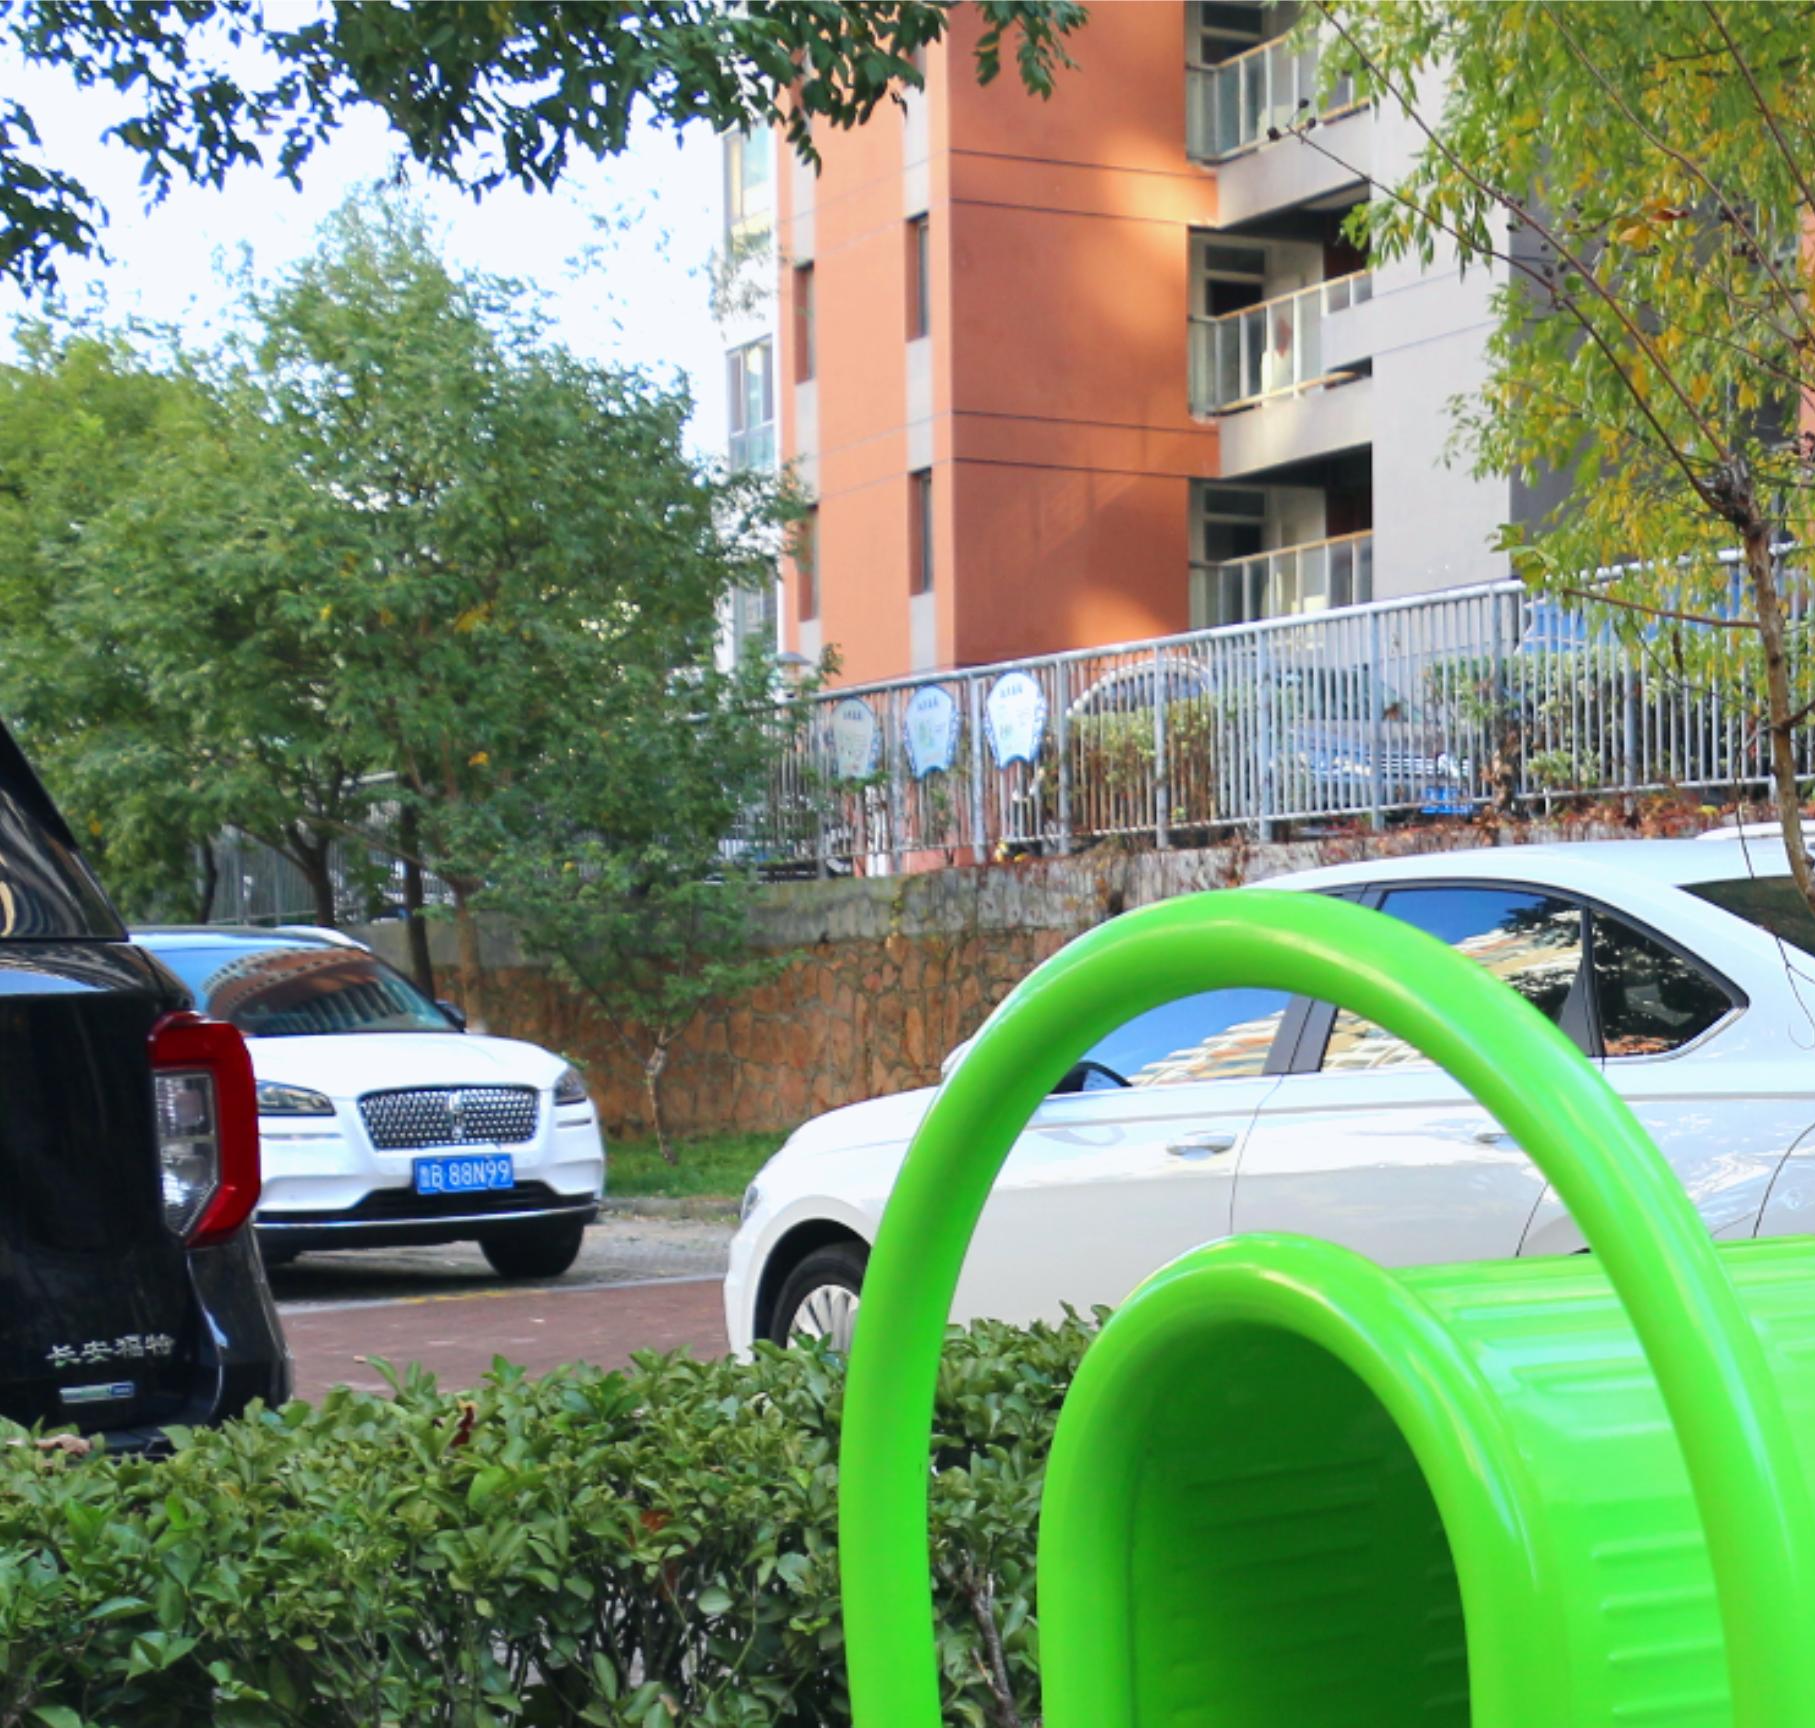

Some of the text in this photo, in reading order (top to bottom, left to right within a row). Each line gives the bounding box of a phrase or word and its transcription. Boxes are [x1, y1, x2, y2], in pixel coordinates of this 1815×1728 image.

[448, 1160, 509, 1185] 88N99
[46, 1333, 174, 1367] 长安福特
